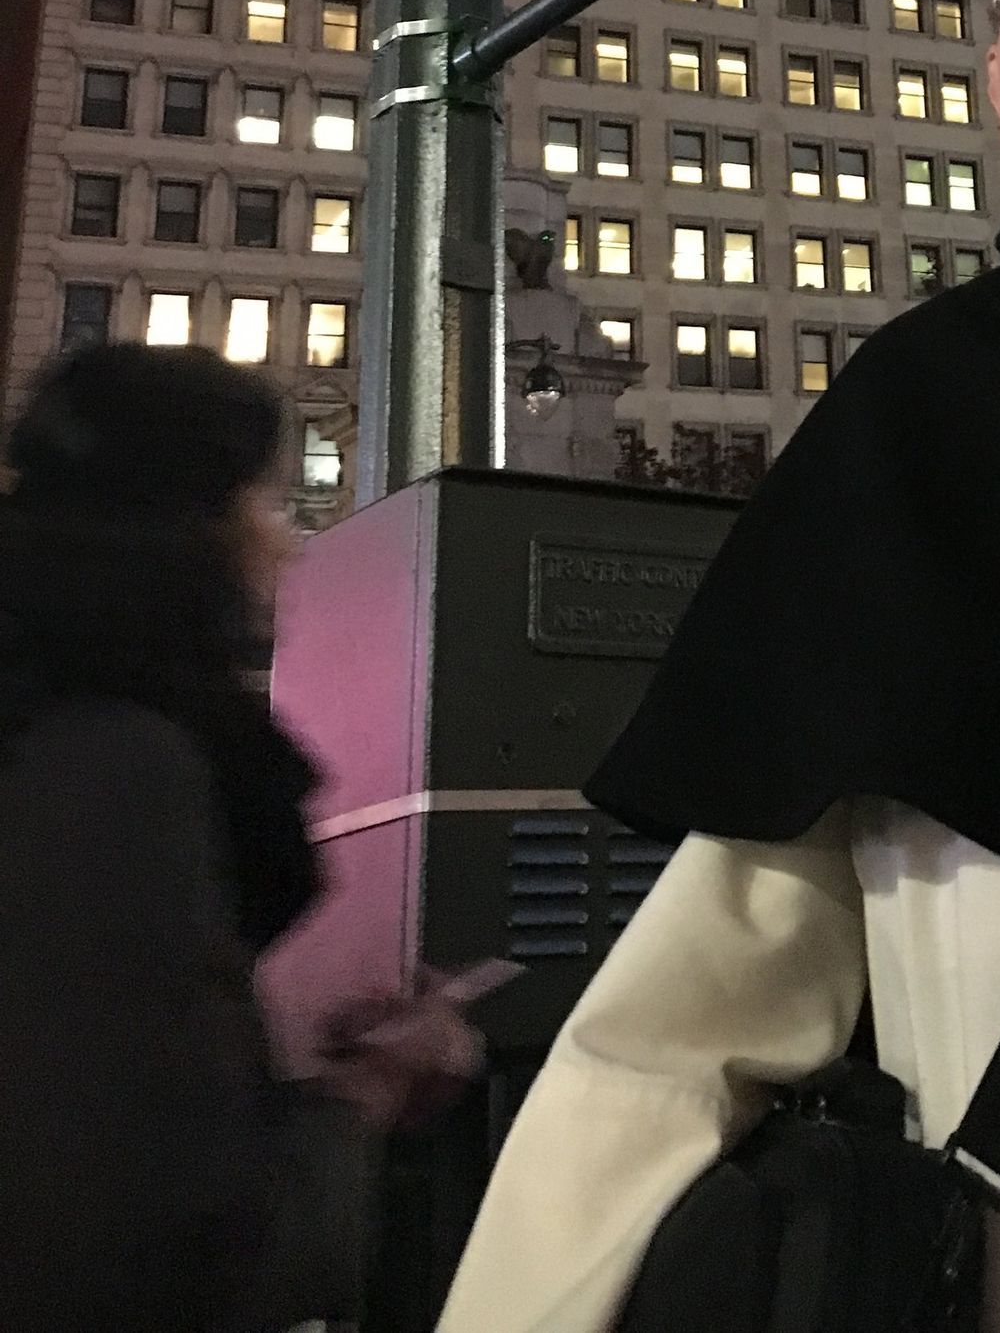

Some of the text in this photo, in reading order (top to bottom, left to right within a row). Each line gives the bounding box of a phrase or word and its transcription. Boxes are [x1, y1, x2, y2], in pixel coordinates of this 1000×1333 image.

[541, 554, 634, 585] TRAFFIC
[553, 605, 677, 636] NEW YORK
